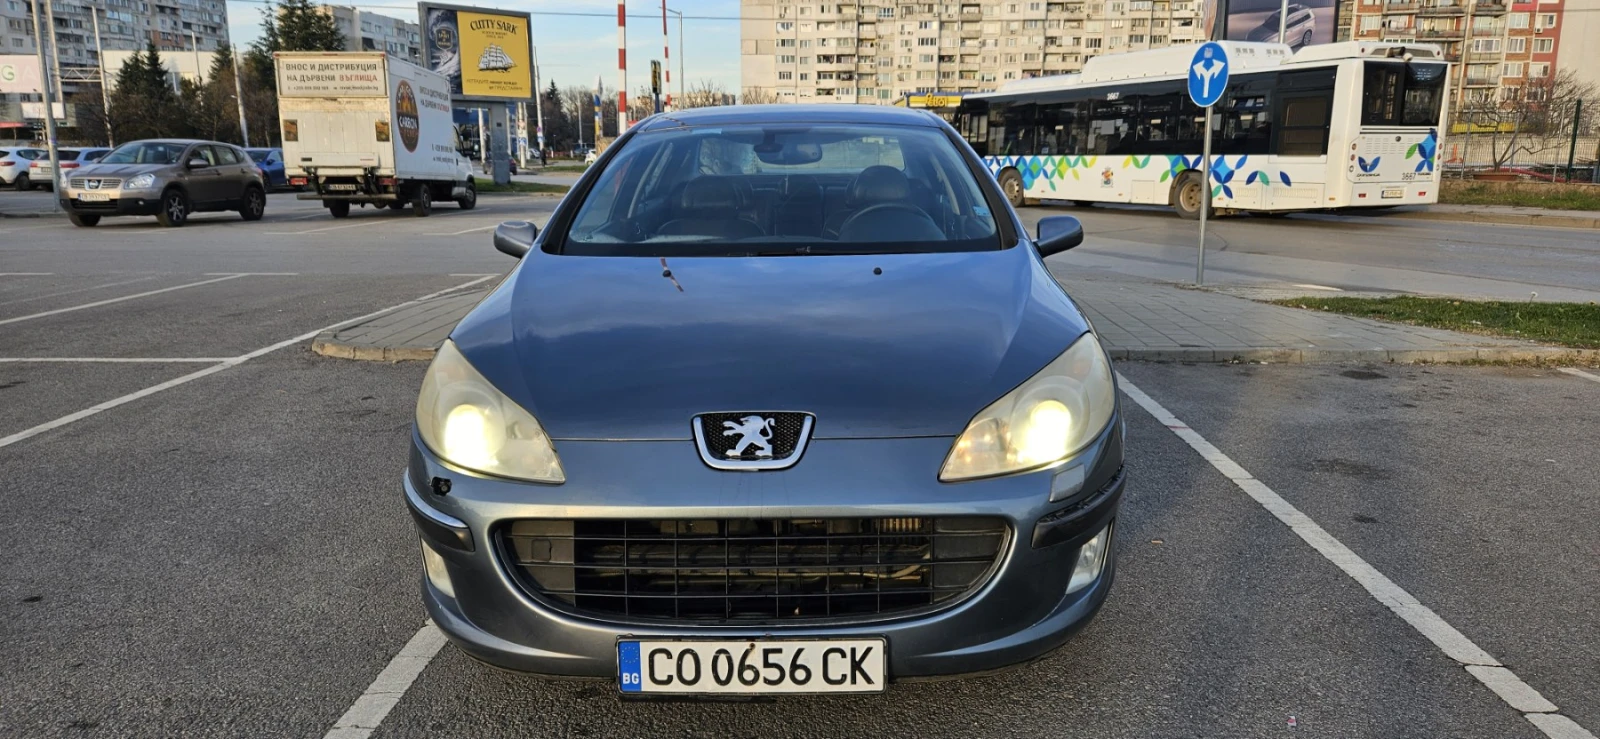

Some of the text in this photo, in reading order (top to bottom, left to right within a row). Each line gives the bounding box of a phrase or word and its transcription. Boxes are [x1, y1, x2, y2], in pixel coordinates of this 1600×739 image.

[470, 19, 495, 31] CUTTY
[496, 20, 517, 35] SARK
[286, 63, 377, 72] ВНОС И ДИСТРИБУЦИЯ
[287, 74, 378, 83] НА ДЪРВЕНИ ВЪГЛИЩА
[1107, 92, 1120, 100] 3667
[399, 115, 418, 129] CARBON
[1402, 172, 1416, 180] 3667
[648, 646, 875, 686] CO 0656 CK
[622, 672, 640, 685] BG
